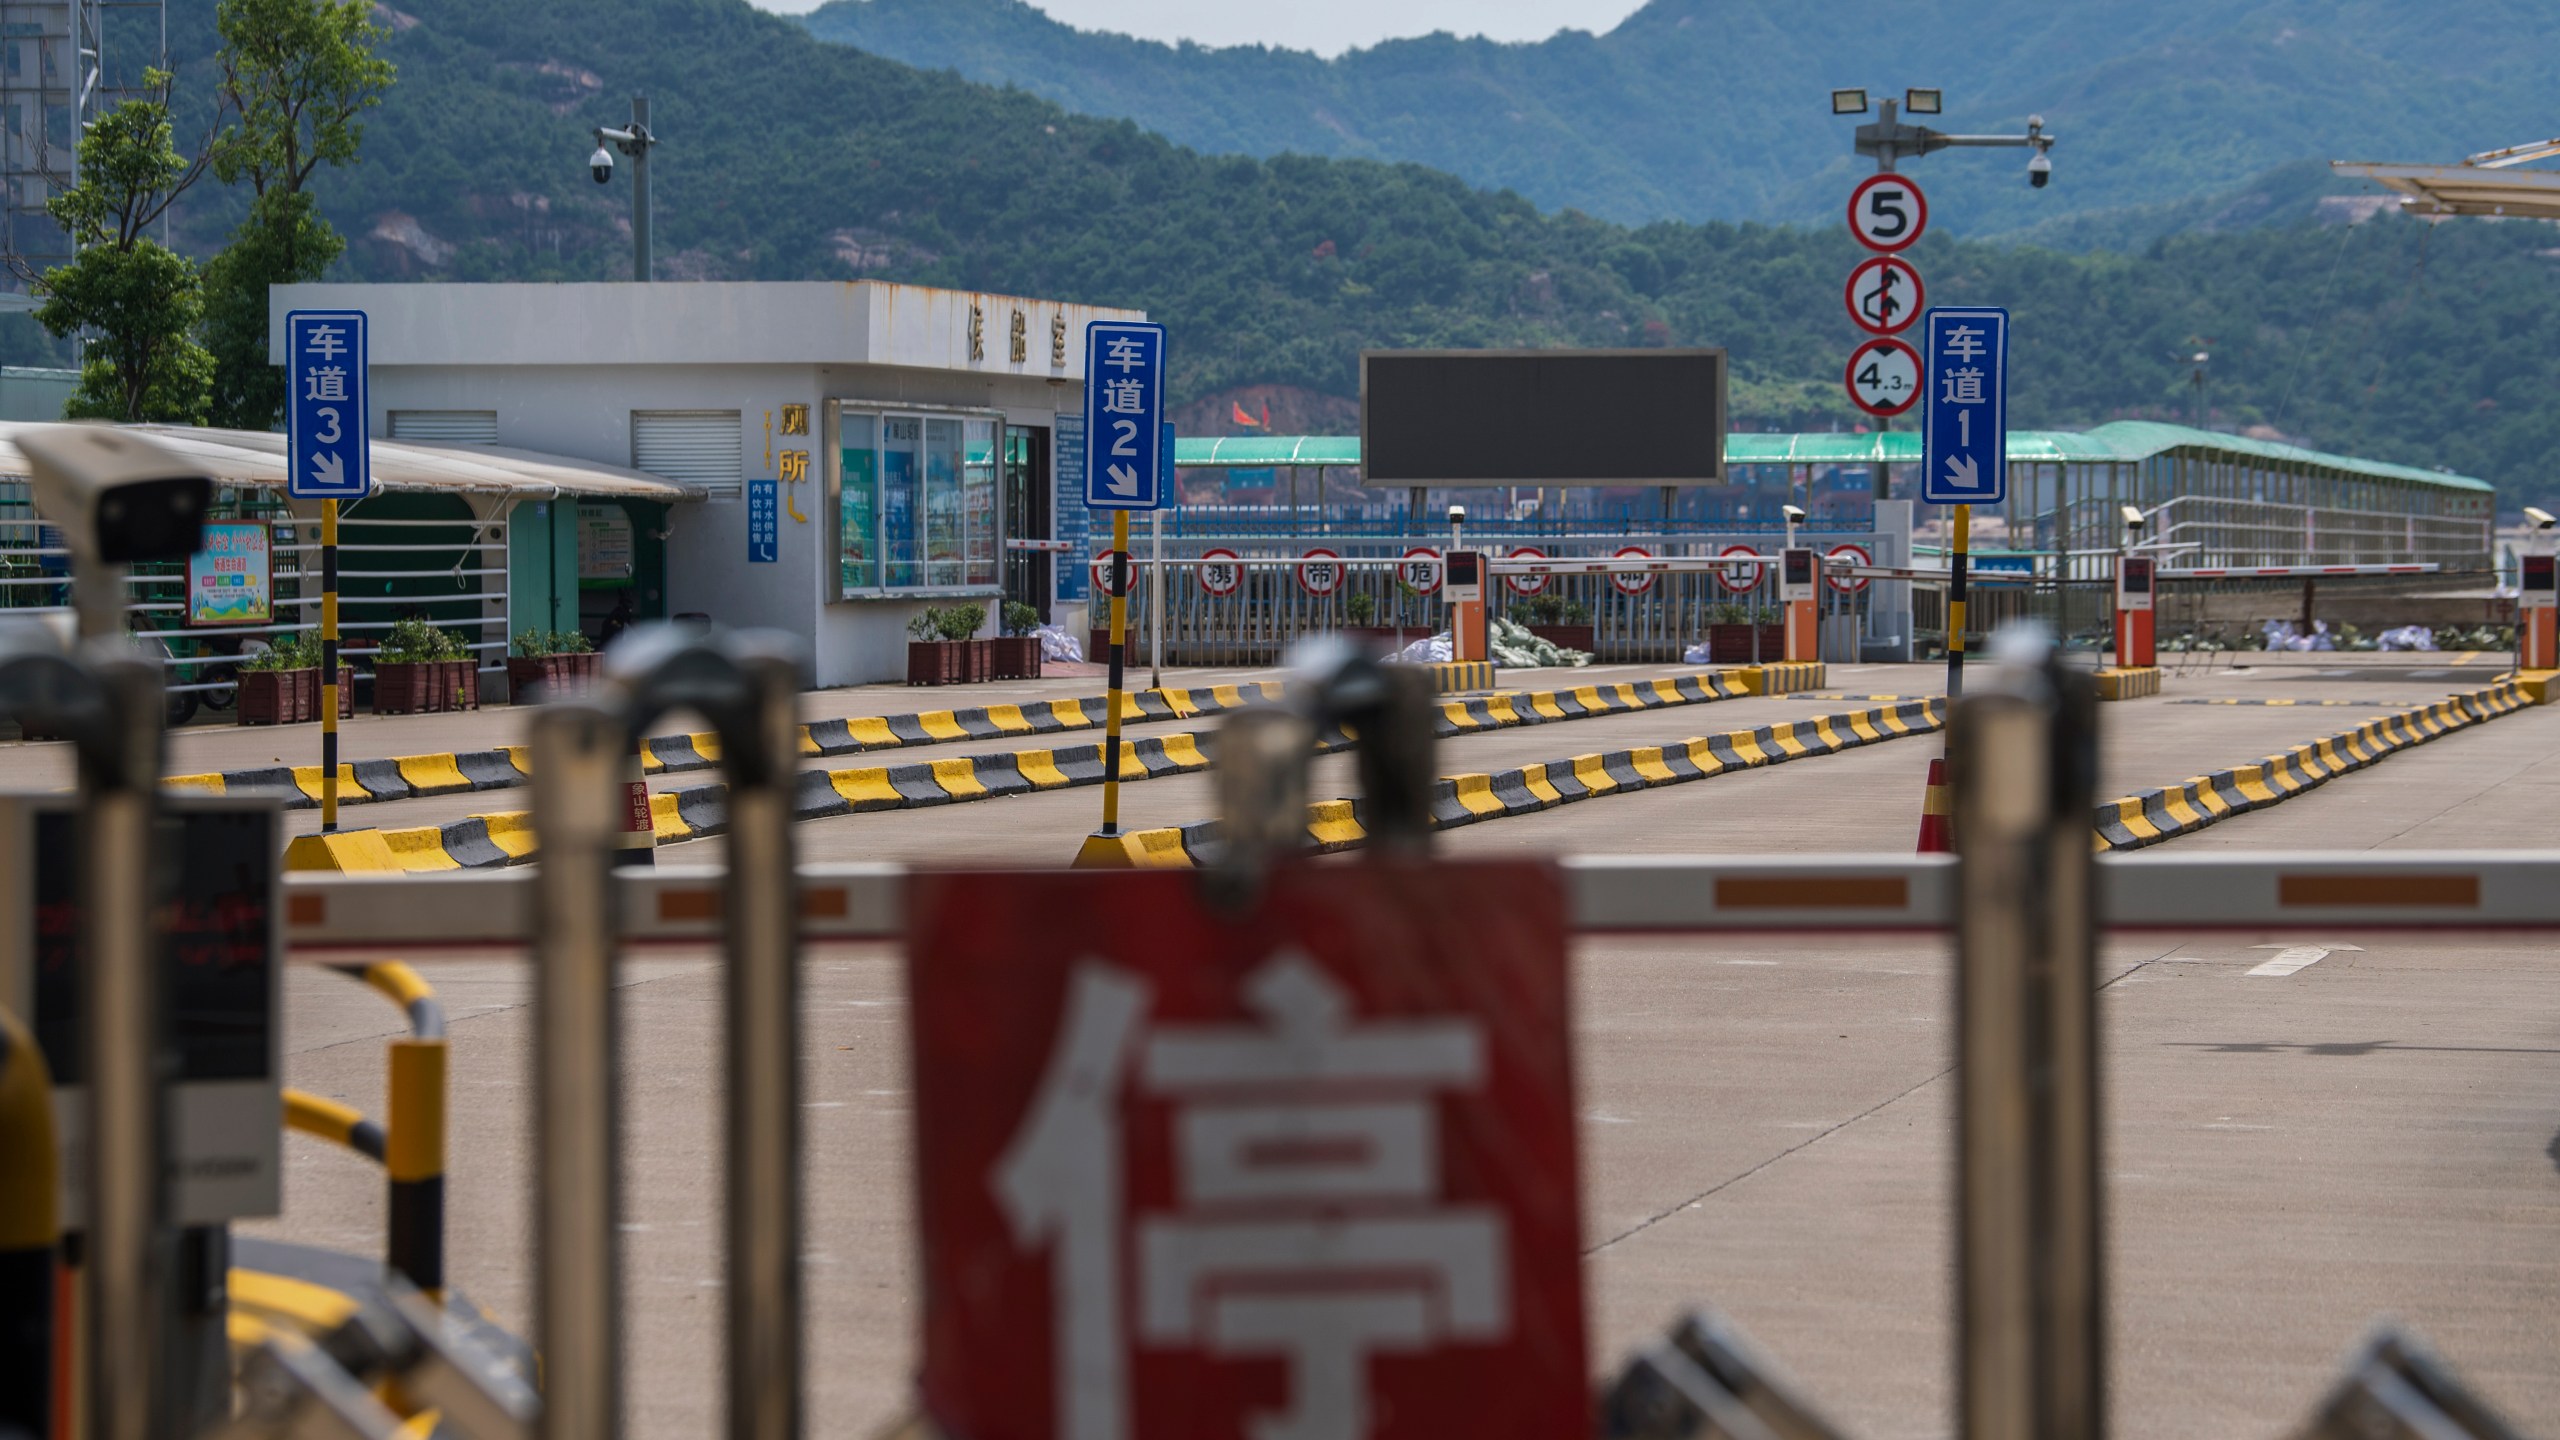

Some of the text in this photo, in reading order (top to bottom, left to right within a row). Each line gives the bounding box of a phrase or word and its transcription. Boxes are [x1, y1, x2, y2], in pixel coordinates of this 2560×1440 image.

[1872, 191, 1907, 238] 5
[306, 324, 349, 444] 车道3
[1103, 336, 1146, 457] 车道2
[1941, 324, 1987, 447] 车道1
[780, 403, 810, 482] 厕所
[631, 783, 649, 831] 象山轮渡
